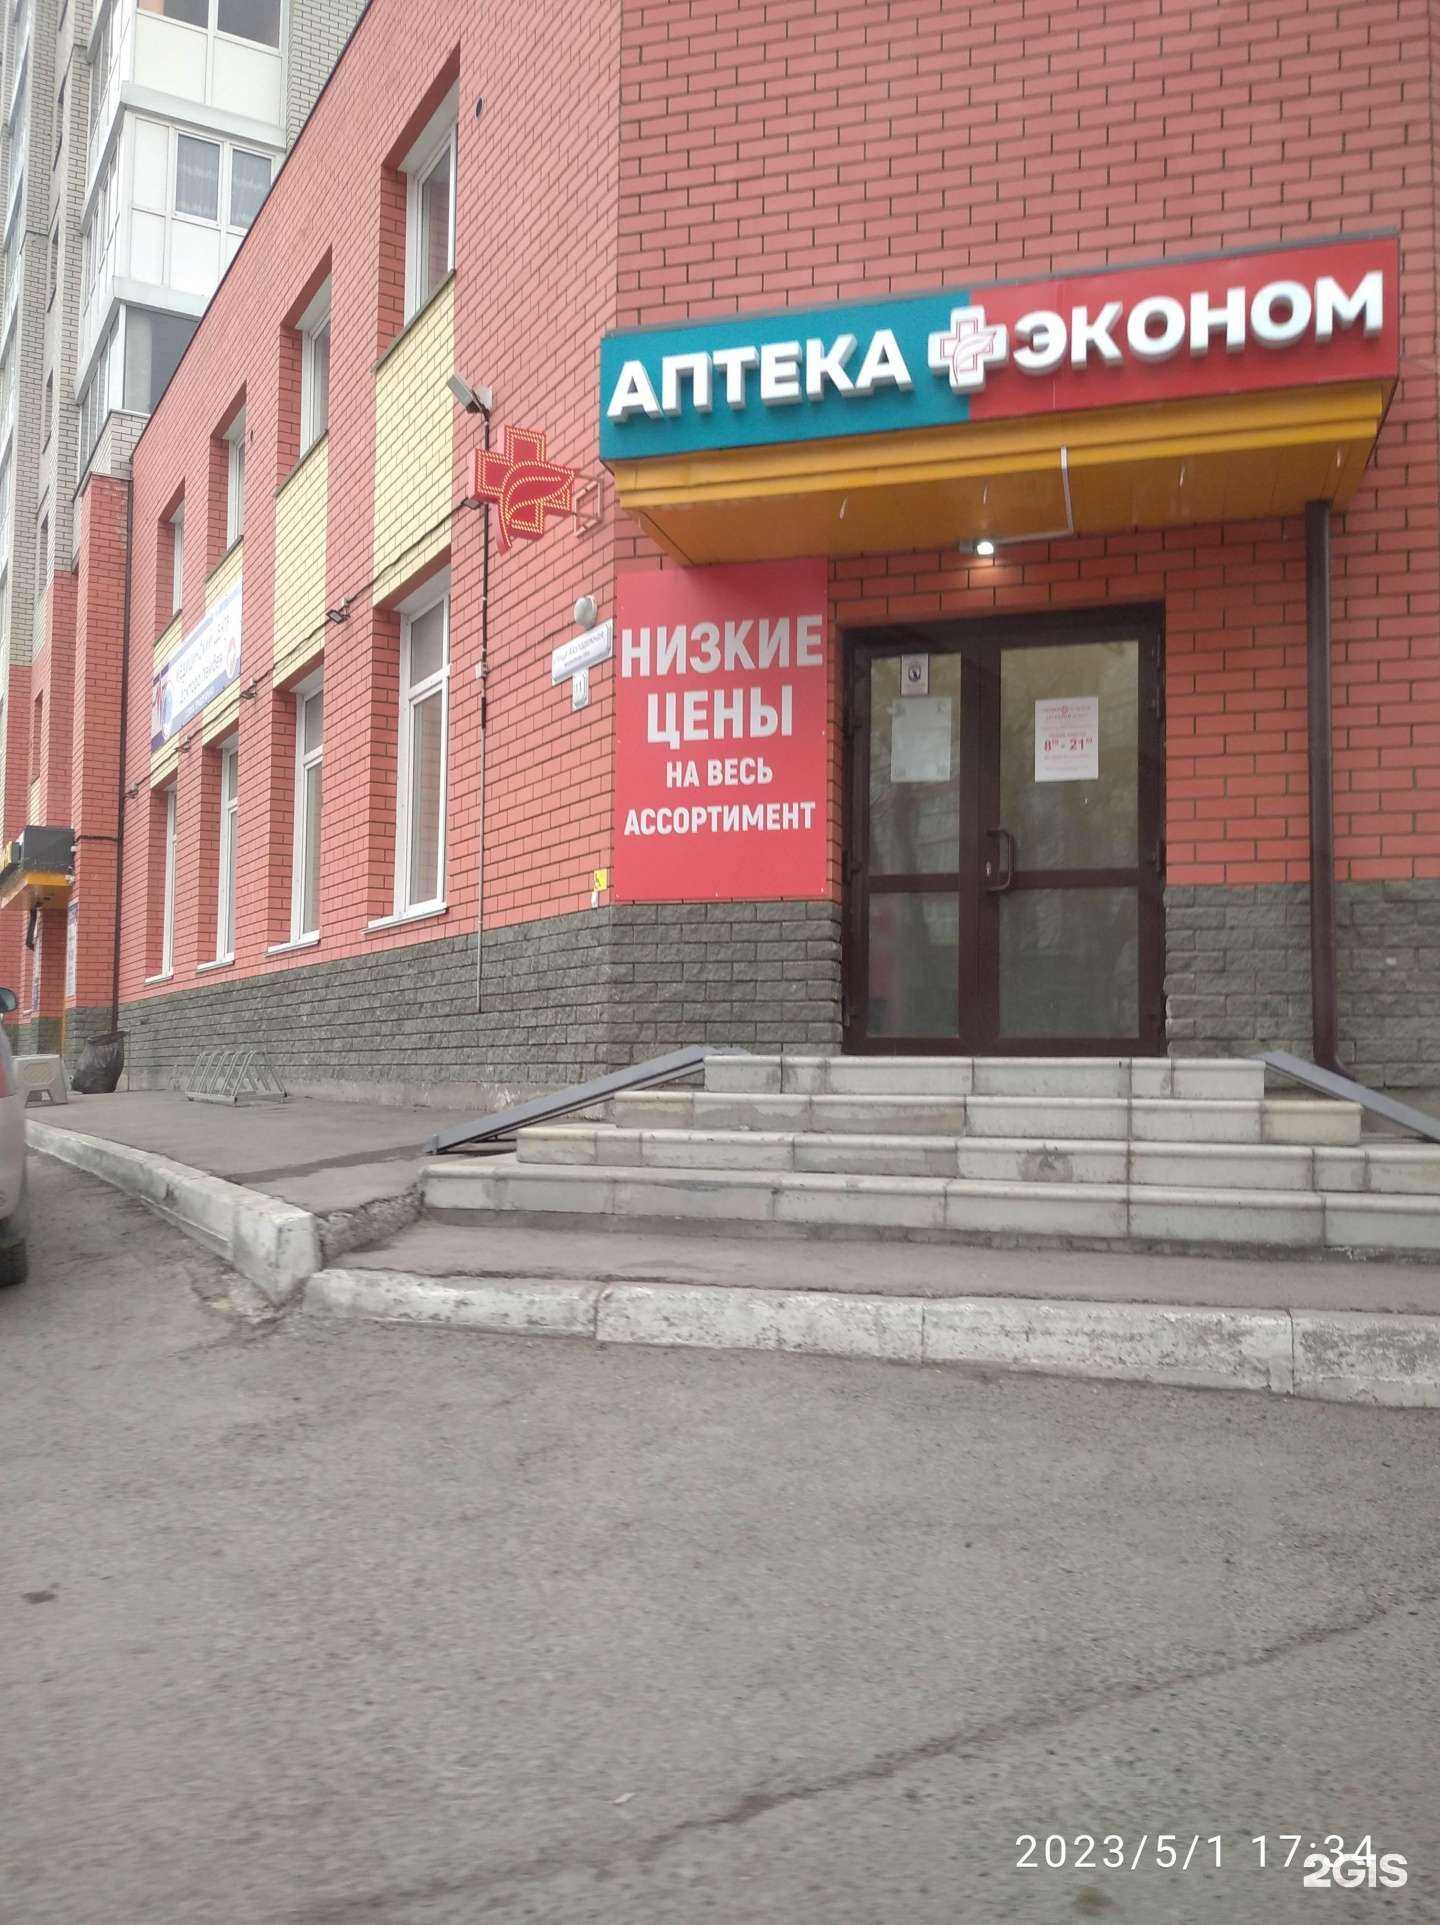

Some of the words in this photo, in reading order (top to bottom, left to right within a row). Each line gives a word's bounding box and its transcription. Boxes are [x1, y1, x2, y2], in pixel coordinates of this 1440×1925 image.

[606, 329, 914, 423] АПТЕКА
[1013, 270, 1385, 375] ЭКОНОМ
[621, 614, 824, 678] НИЗКИЕ
[647, 685, 793, 750] ЦЕНЫ
[666, 760, 700, 788] НА
[707, 757, 773, 786] ВЕСЬ
[623, 801, 816, 836] АССОРТИМЕНТ
